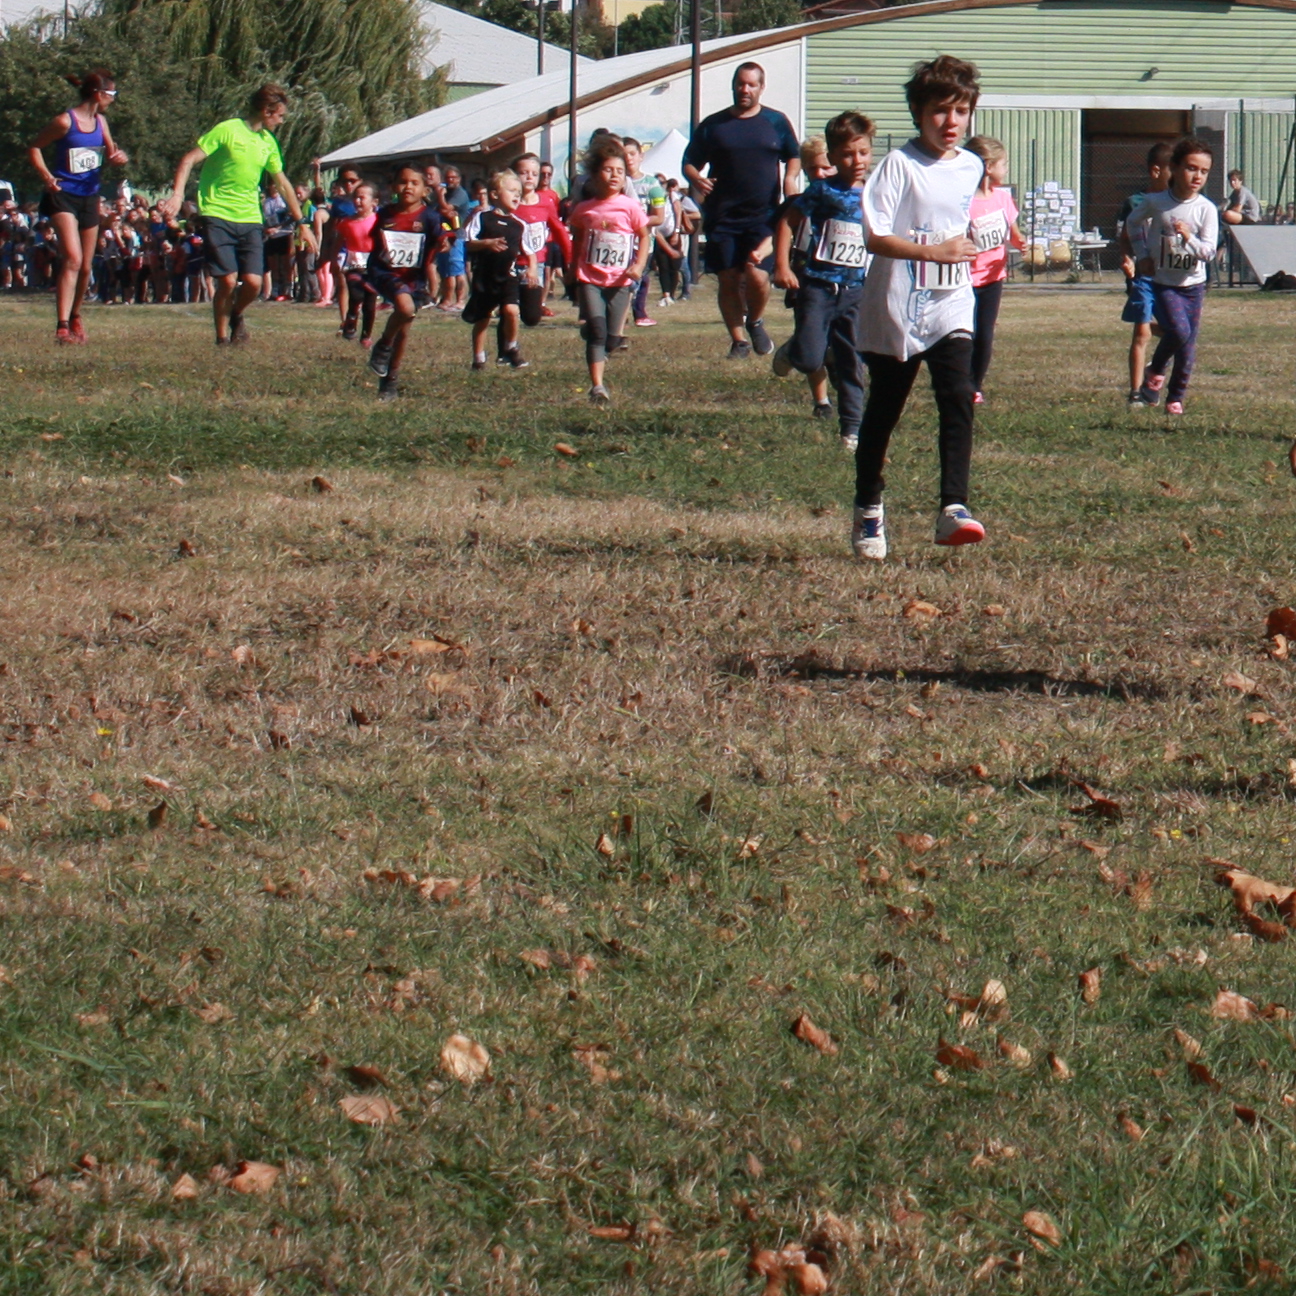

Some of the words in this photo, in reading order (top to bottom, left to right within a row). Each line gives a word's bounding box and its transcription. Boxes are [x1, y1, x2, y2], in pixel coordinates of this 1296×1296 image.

[980, 228, 1005, 250] 1191
[595, 247, 625, 267] 1234
[830, 240, 866, 264] 1223
